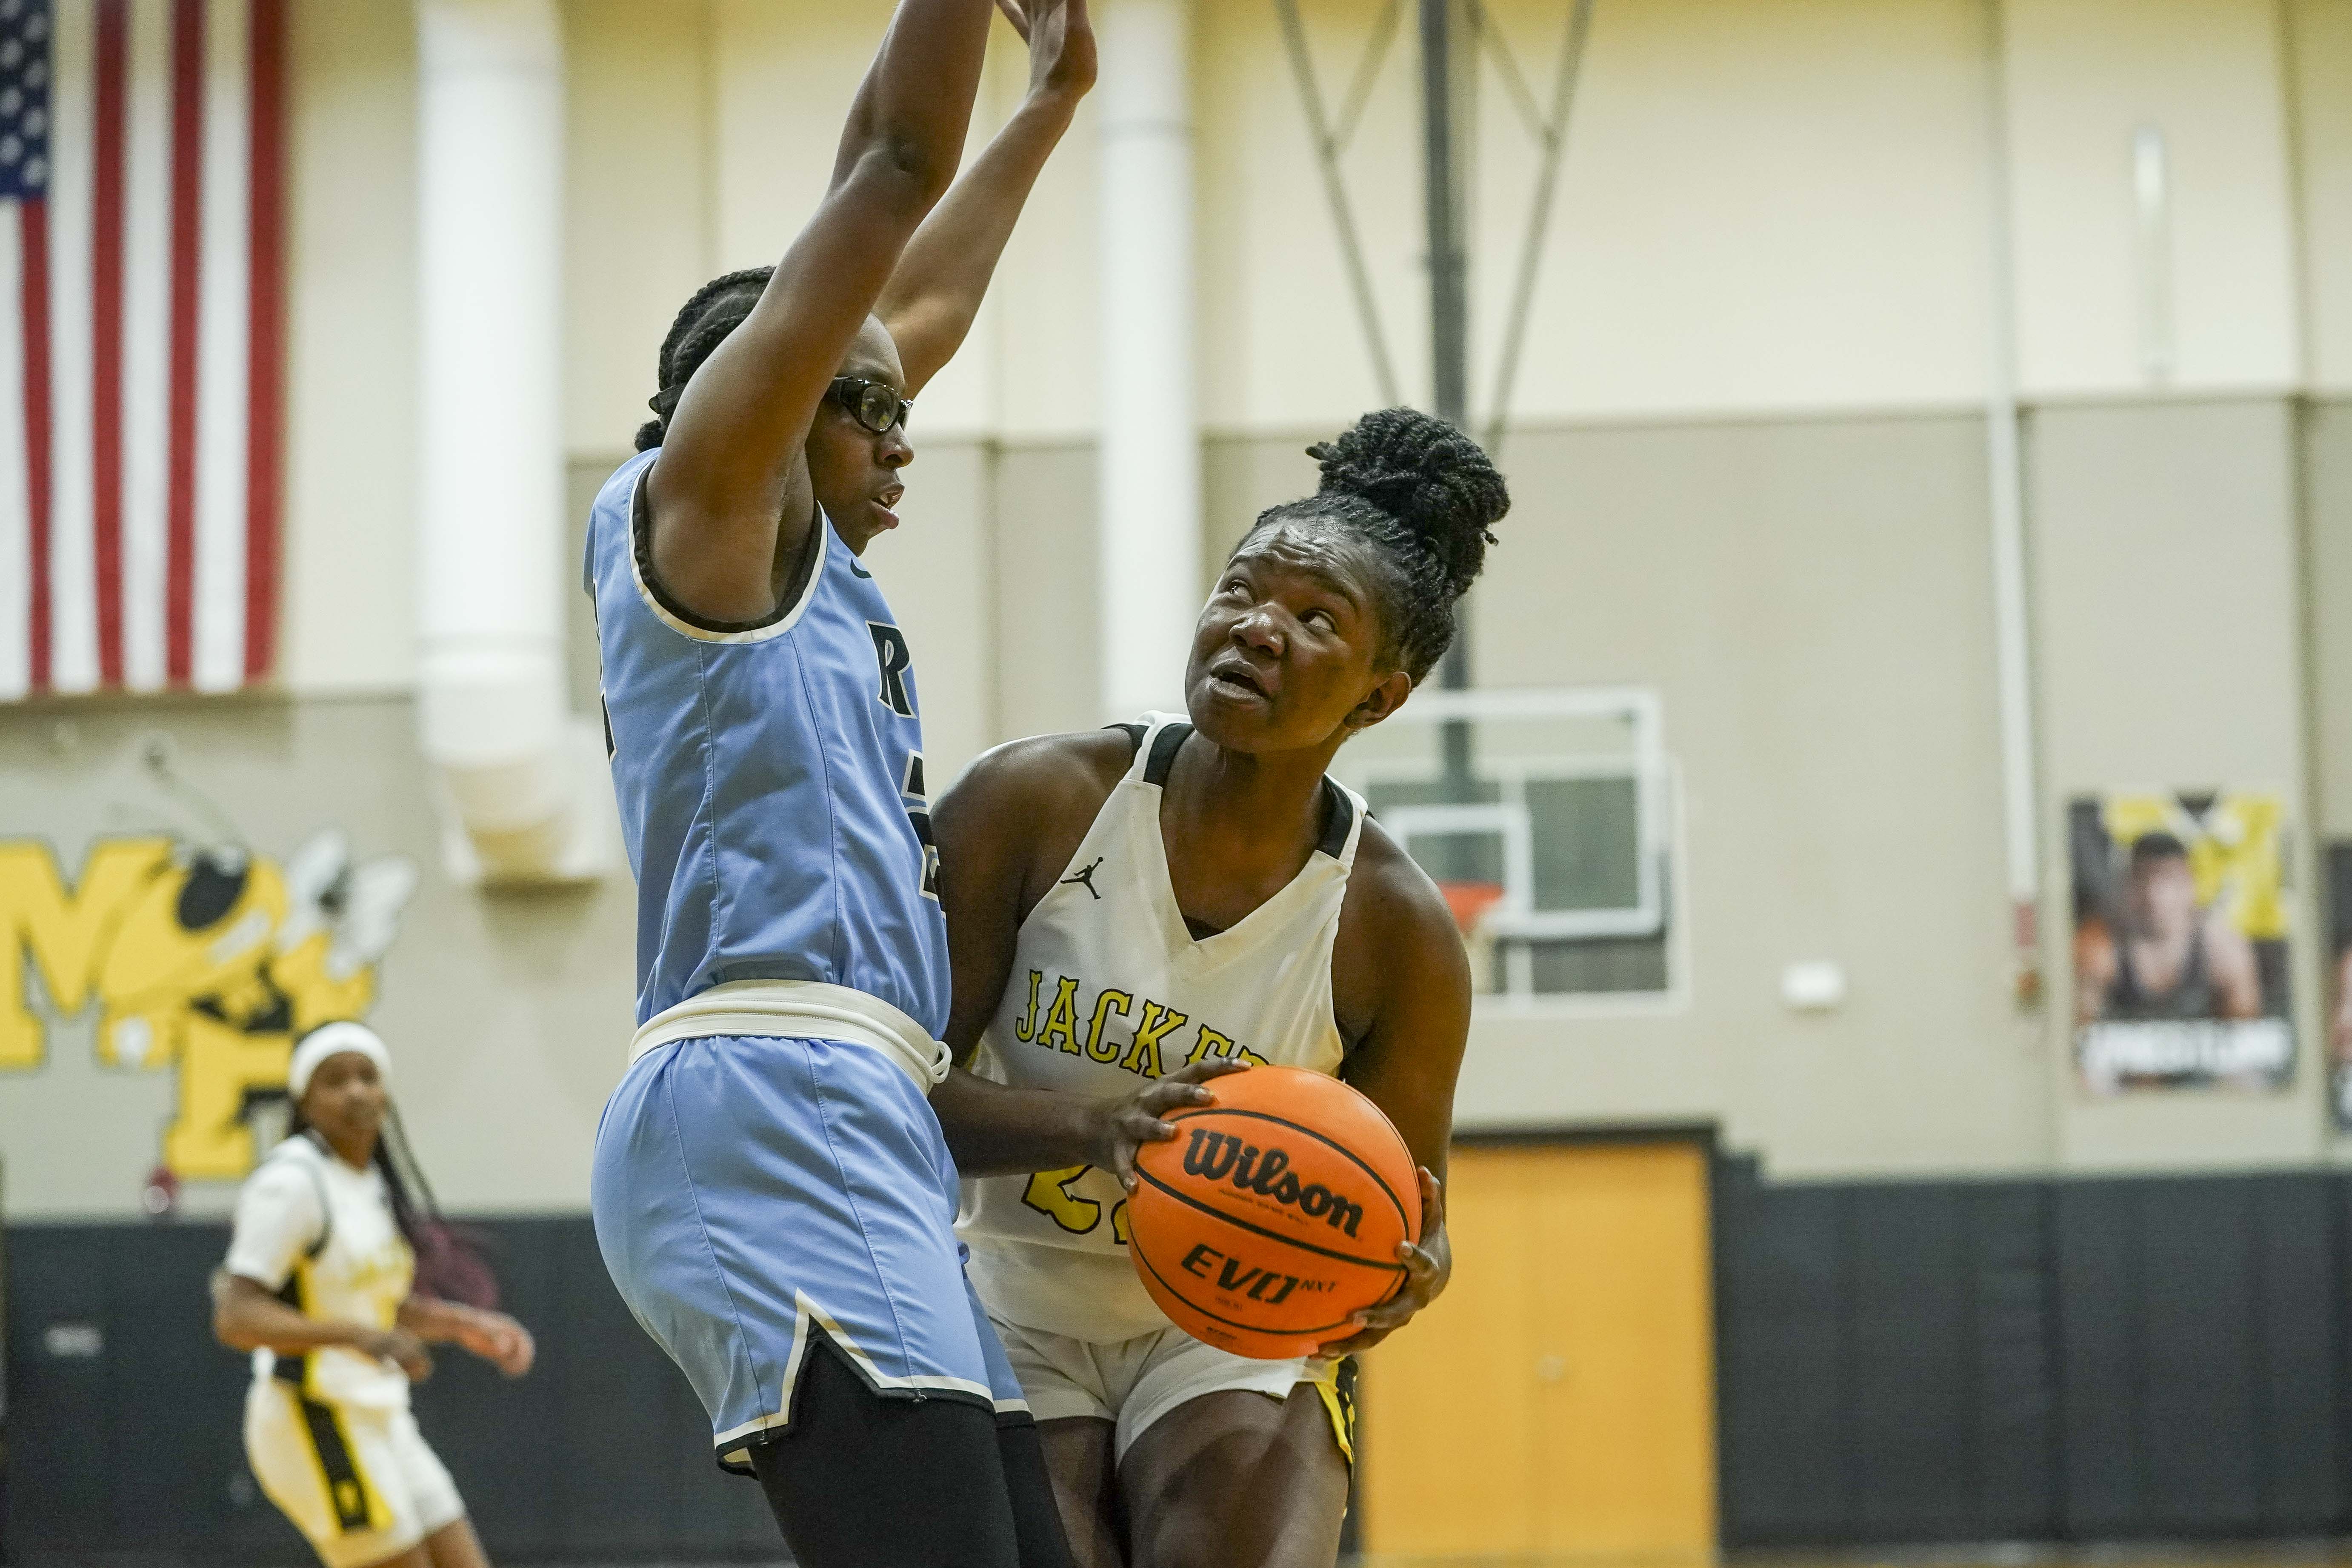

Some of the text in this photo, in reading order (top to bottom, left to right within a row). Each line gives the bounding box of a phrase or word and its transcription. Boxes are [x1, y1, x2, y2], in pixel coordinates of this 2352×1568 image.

[866, 620, 917, 719] R
[1183, 1128, 1364, 1238] Wilson
[1181, 1243, 1300, 1305] EVO
